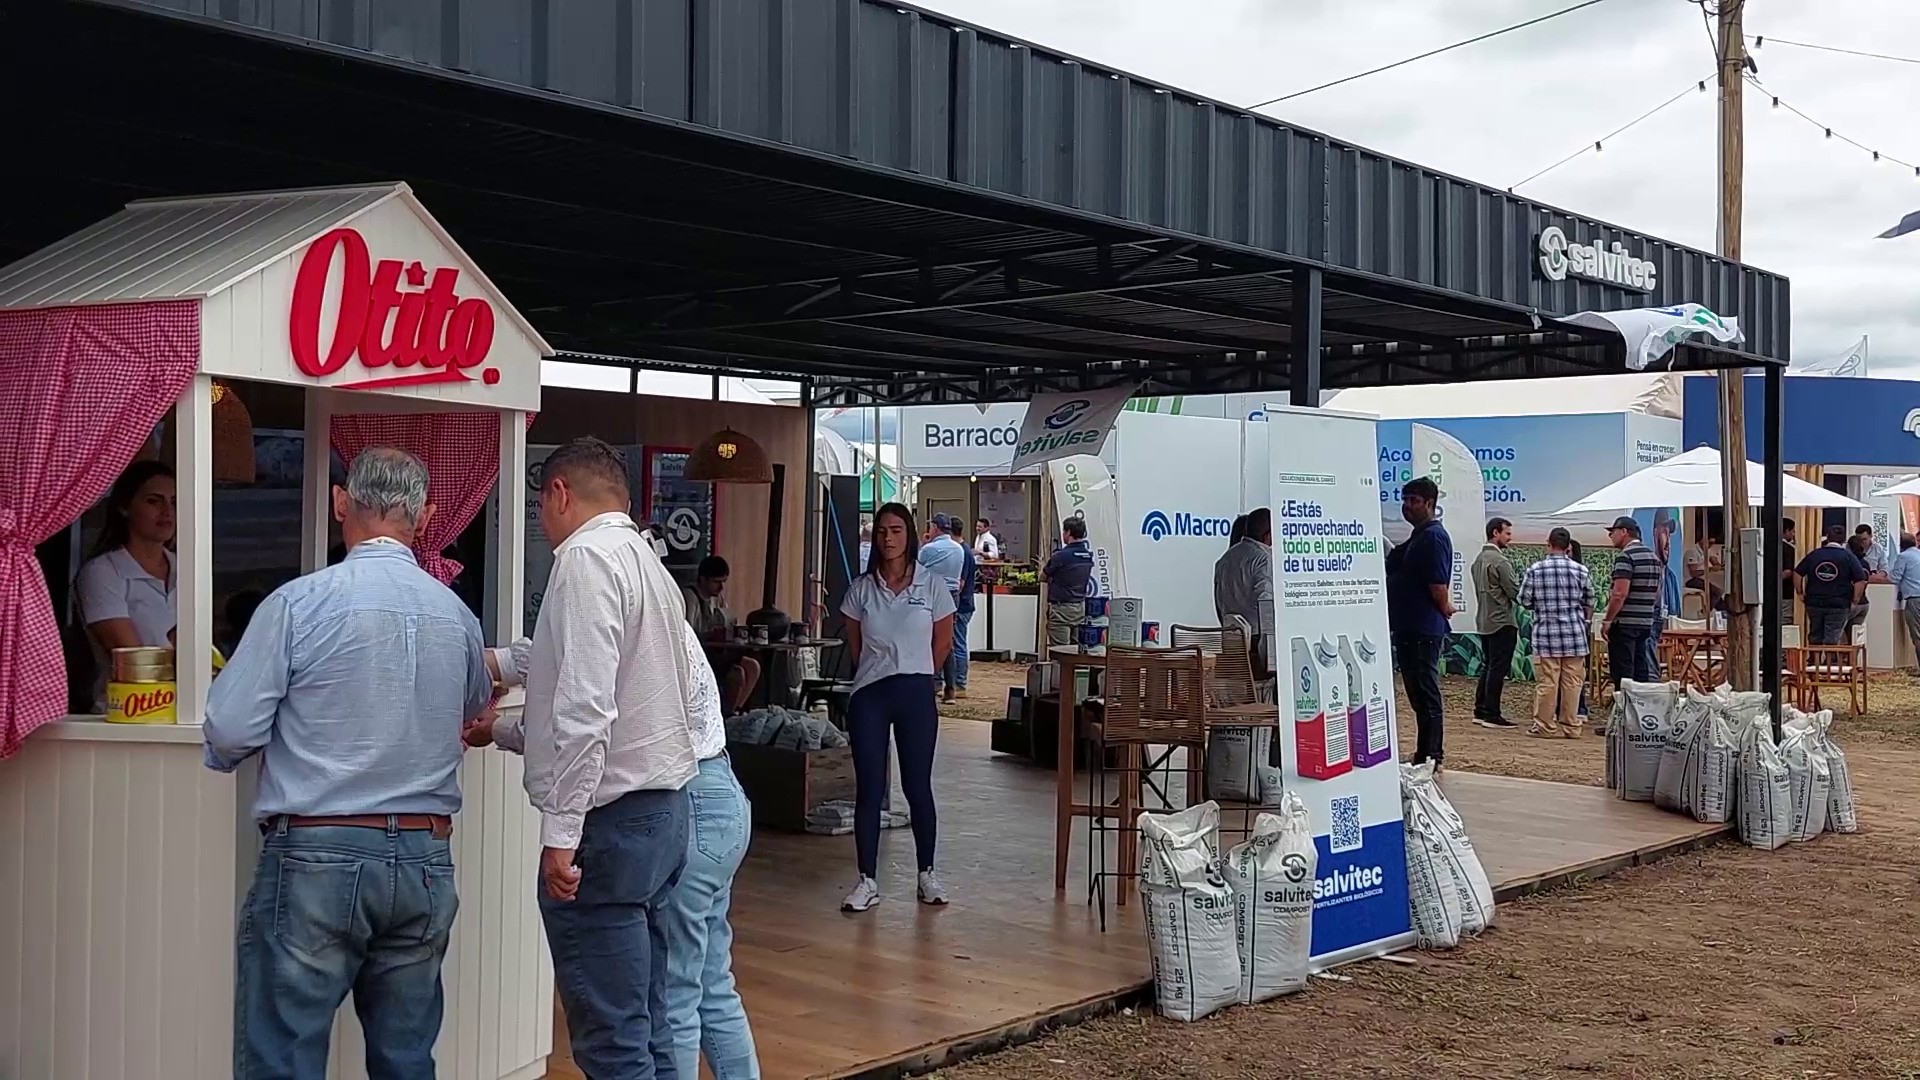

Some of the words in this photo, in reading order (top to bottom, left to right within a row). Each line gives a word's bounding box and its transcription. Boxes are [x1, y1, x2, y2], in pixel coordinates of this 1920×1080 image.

[1567, 239, 1656, 291] salvitec
[1381, 466, 1396, 482] el
[1281, 500, 1323, 518] ¿Estás
[1175, 512, 1231, 537] Macro
[1282, 519, 1364, 540] aprovechando
[1283, 537, 1311, 554] todo
[1314, 537, 1325, 554] el
[1327, 537, 1377, 558] potencial
[1284, 556, 1300, 573] de
[1303, 557, 1314, 572] tu
[1317, 555, 1353, 572] suelo?
[124, 688, 175, 718] Otito
[1313, 864, 1383, 900] salvitec
[1415, 854, 1435, 899] COMPOST
[1263, 886, 1312, 903] salvite
[1459, 887, 1470, 901] 25
[1465, 901, 1475, 912] kg
[1239, 893, 1247, 948] COMPOST
[1410, 898, 1426, 936] salvitec
[1431, 906, 1442, 920] 25
[1168, 902, 1180, 958] COMPOST
[1436, 921, 1445, 933] kg
[1175, 968, 1186, 984] 25
[1174, 985, 1185, 1000] kg
